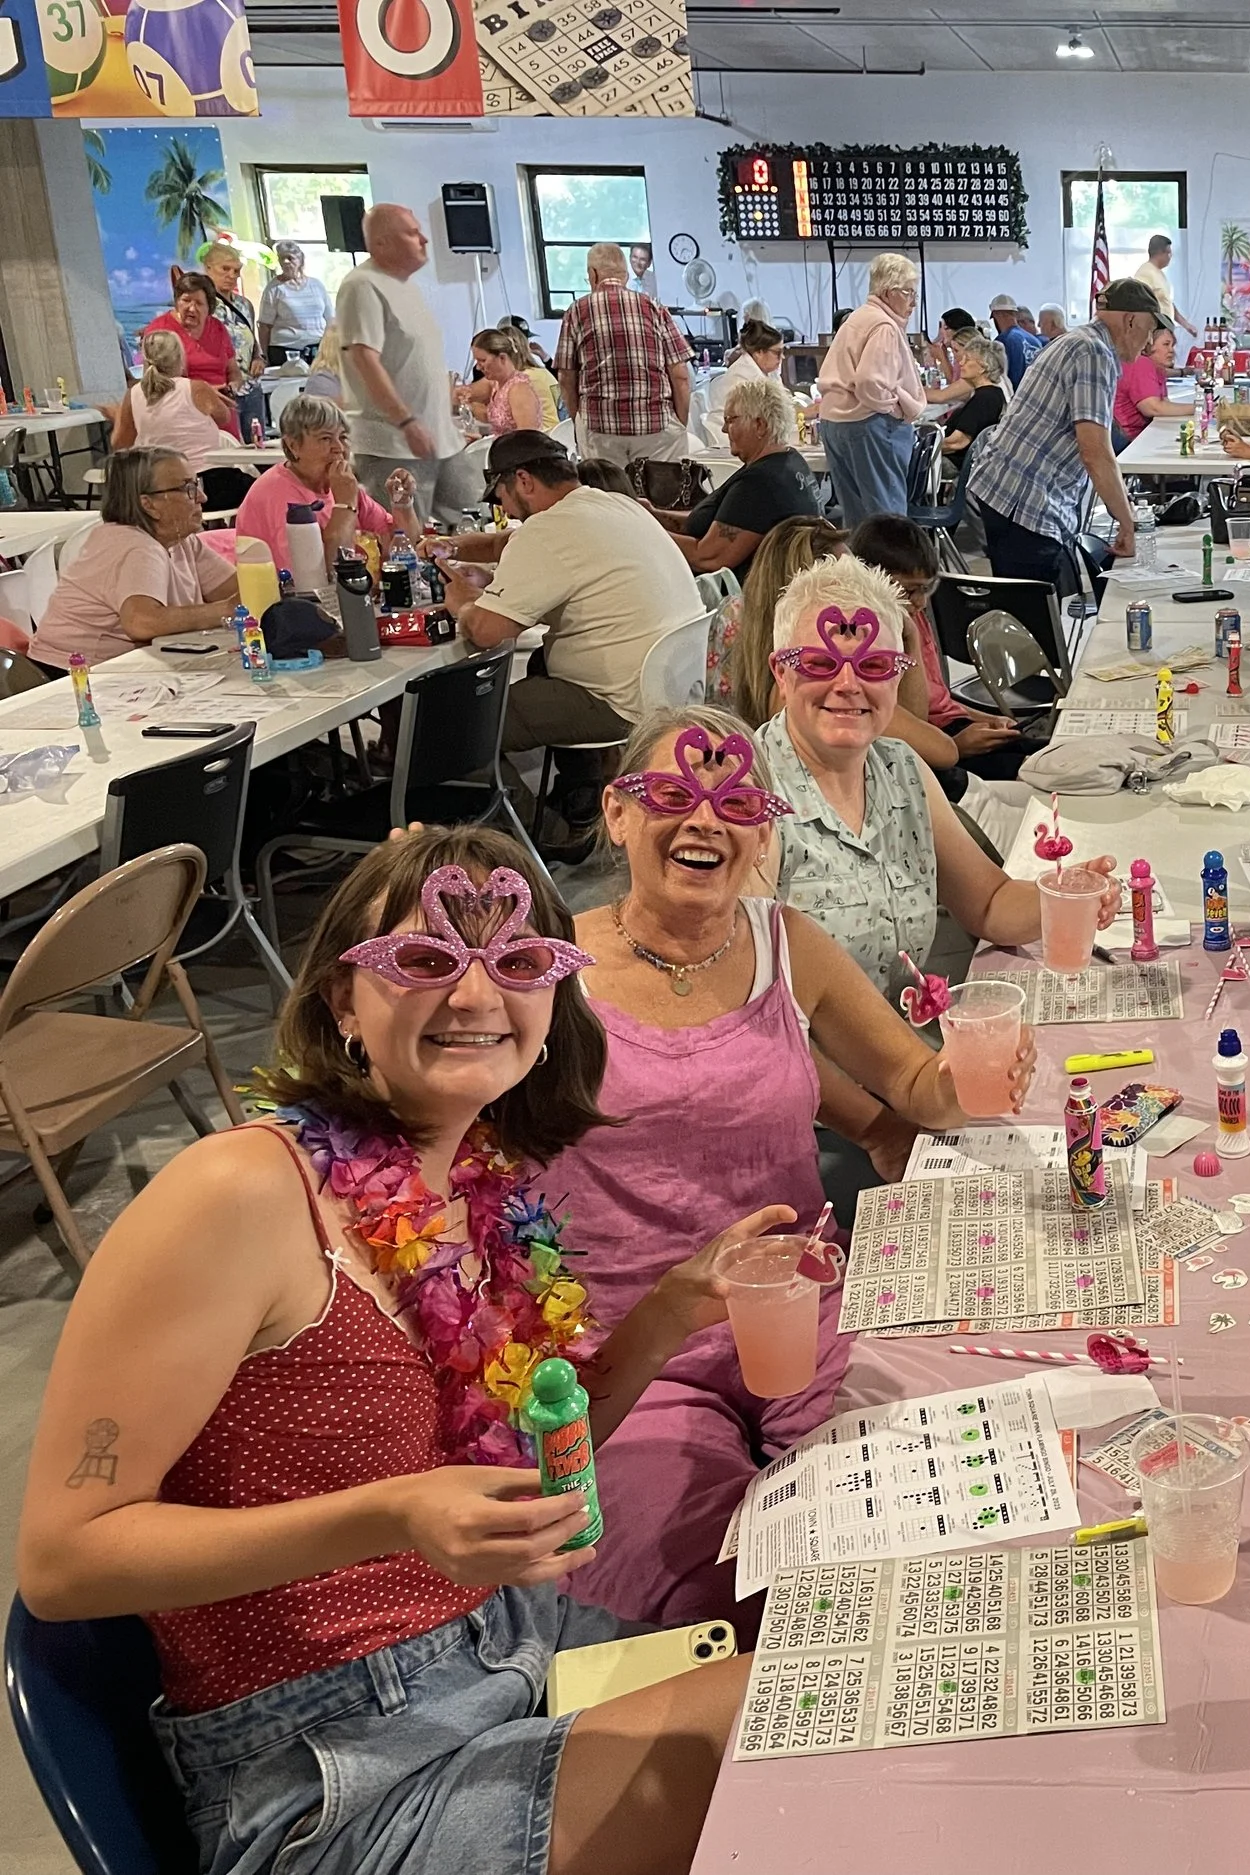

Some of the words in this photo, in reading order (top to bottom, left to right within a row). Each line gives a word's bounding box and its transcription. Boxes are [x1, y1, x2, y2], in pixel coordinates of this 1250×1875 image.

[46, 0, 86, 42] 37
[562, 14, 577, 27] 35
[584, 1, 602, 14] 58
[550, 44, 568, 57] 16
[578, 30, 594, 42] 44
[626, 2, 644, 14] 70
[621, 28, 636, 42] 57
[644, 14, 662, 28] 71
[508, 43, 527, 56] 14
[586, 38, 612, 56] FREE
[594, 44, 618, 62] SPACE
[613, 60, 630, 74] 45
[662, 29, 681, 44] 72
[529, 60, 540, 72] 5
[567, 60, 587, 74] 30
[132, 64, 166, 106] 07
[542, 74, 560, 87] 10
[601, 88, 618, 102] 27
[630, 74, 646, 86] 31
[656, 58, 674, 72] 46
[666, 100, 685, 112] 13
[754, 160, 768, 184] 0
[810, 161, 814, 174] 1
[823, 162, 828, 174] 2
[836, 162, 842, 174] 3
[849, 162, 855, 174] 4
[863, 162, 869, 174] 5
[877, 162, 883, 174] 6
[890, 162, 895, 174] 7
[906, 162, 912, 174] 8
[919, 162, 925, 174] 9
[931, 162, 940, 174] 10
[944, 162, 952, 174] 11
[957, 162, 966, 174] 12
[970, 162, 980, 174] 13
[984, 162, 994, 174] 14
[997, 162, 1006, 174] 15
[811, 224, 822, 237] 61
[824, 224, 836, 237] 62
[838, 224, 849, 237] 63
[851, 224, 862, 237] 64
[864, 224, 876, 237] 65
[878, 224, 889, 237] 66
[891, 224, 902, 237] 67
[907, 225, 918, 237] 68
[920, 225, 931, 237] 69
[934, 225, 944, 237] 70
[947, 225, 957, 237] 71
[960, 225, 970, 237] 72
[973, 225, 984, 237] 73
[986, 225, 997, 237] 74
[999, 225, 1010, 237] 75
[1064, 1270, 1075, 1278] 30
[1049, 1280, 1060, 1289] 32
[1065, 1280, 1076, 1288] 31
[1050, 1290, 1060, 1299] 50
[1066, 1290, 1076, 1299] 60
[1050, 1301, 1061, 1310] 66
[1066, 1300, 1077, 1309] 67
[1028, 1400, 1038, 1420] SQUARE
[1036, 1434, 1048, 1458] FLAMINGO
[1042, 1458, 1051, 1472] BINGO
[1047, 1474, 1056, 1488] JULY
[1104, 1446, 1119, 1457] 15
[1103, 1464, 1118, 1475] 16
[1119, 1474, 1135, 1484] 41
[562, 1478, 581, 1493] THE
[808, 1508, 817, 1527] TOWN
[810, 1536, 820, 1562] SQUARE
[1077, 1634, 1091, 1648] 14
[1098, 1632, 1112, 1646] 13
[850, 1656, 864, 1664] 7
[1055, 1654, 1069, 1668] 24
[1077, 1651, 1091, 1666] 16
[1098, 1648, 1113, 1663] 30
[1120, 1647, 1134, 1661] 21
[847, 1671, 863, 1686] 25
[1055, 1670, 1070, 1685] 36
[1099, 1665, 1114, 1681] 45
[1120, 1664, 1135, 1680] 39
[844, 1689, 860, 1706] 36
[1055, 1688, 1070, 1703] 48
[1077, 1686, 1092, 1702] 50
[1100, 1684, 1114, 1700] 46
[1121, 1682, 1136, 1698] 58
[842, 1707, 858, 1724] 53
[1055, 1706, 1070, 1721] 61
[1078, 1705, 1092, 1720] 66
[1100, 1702, 1115, 1719] 68
[1122, 1702, 1138, 1717] 73
[838, 1726, 855, 1743] 74
